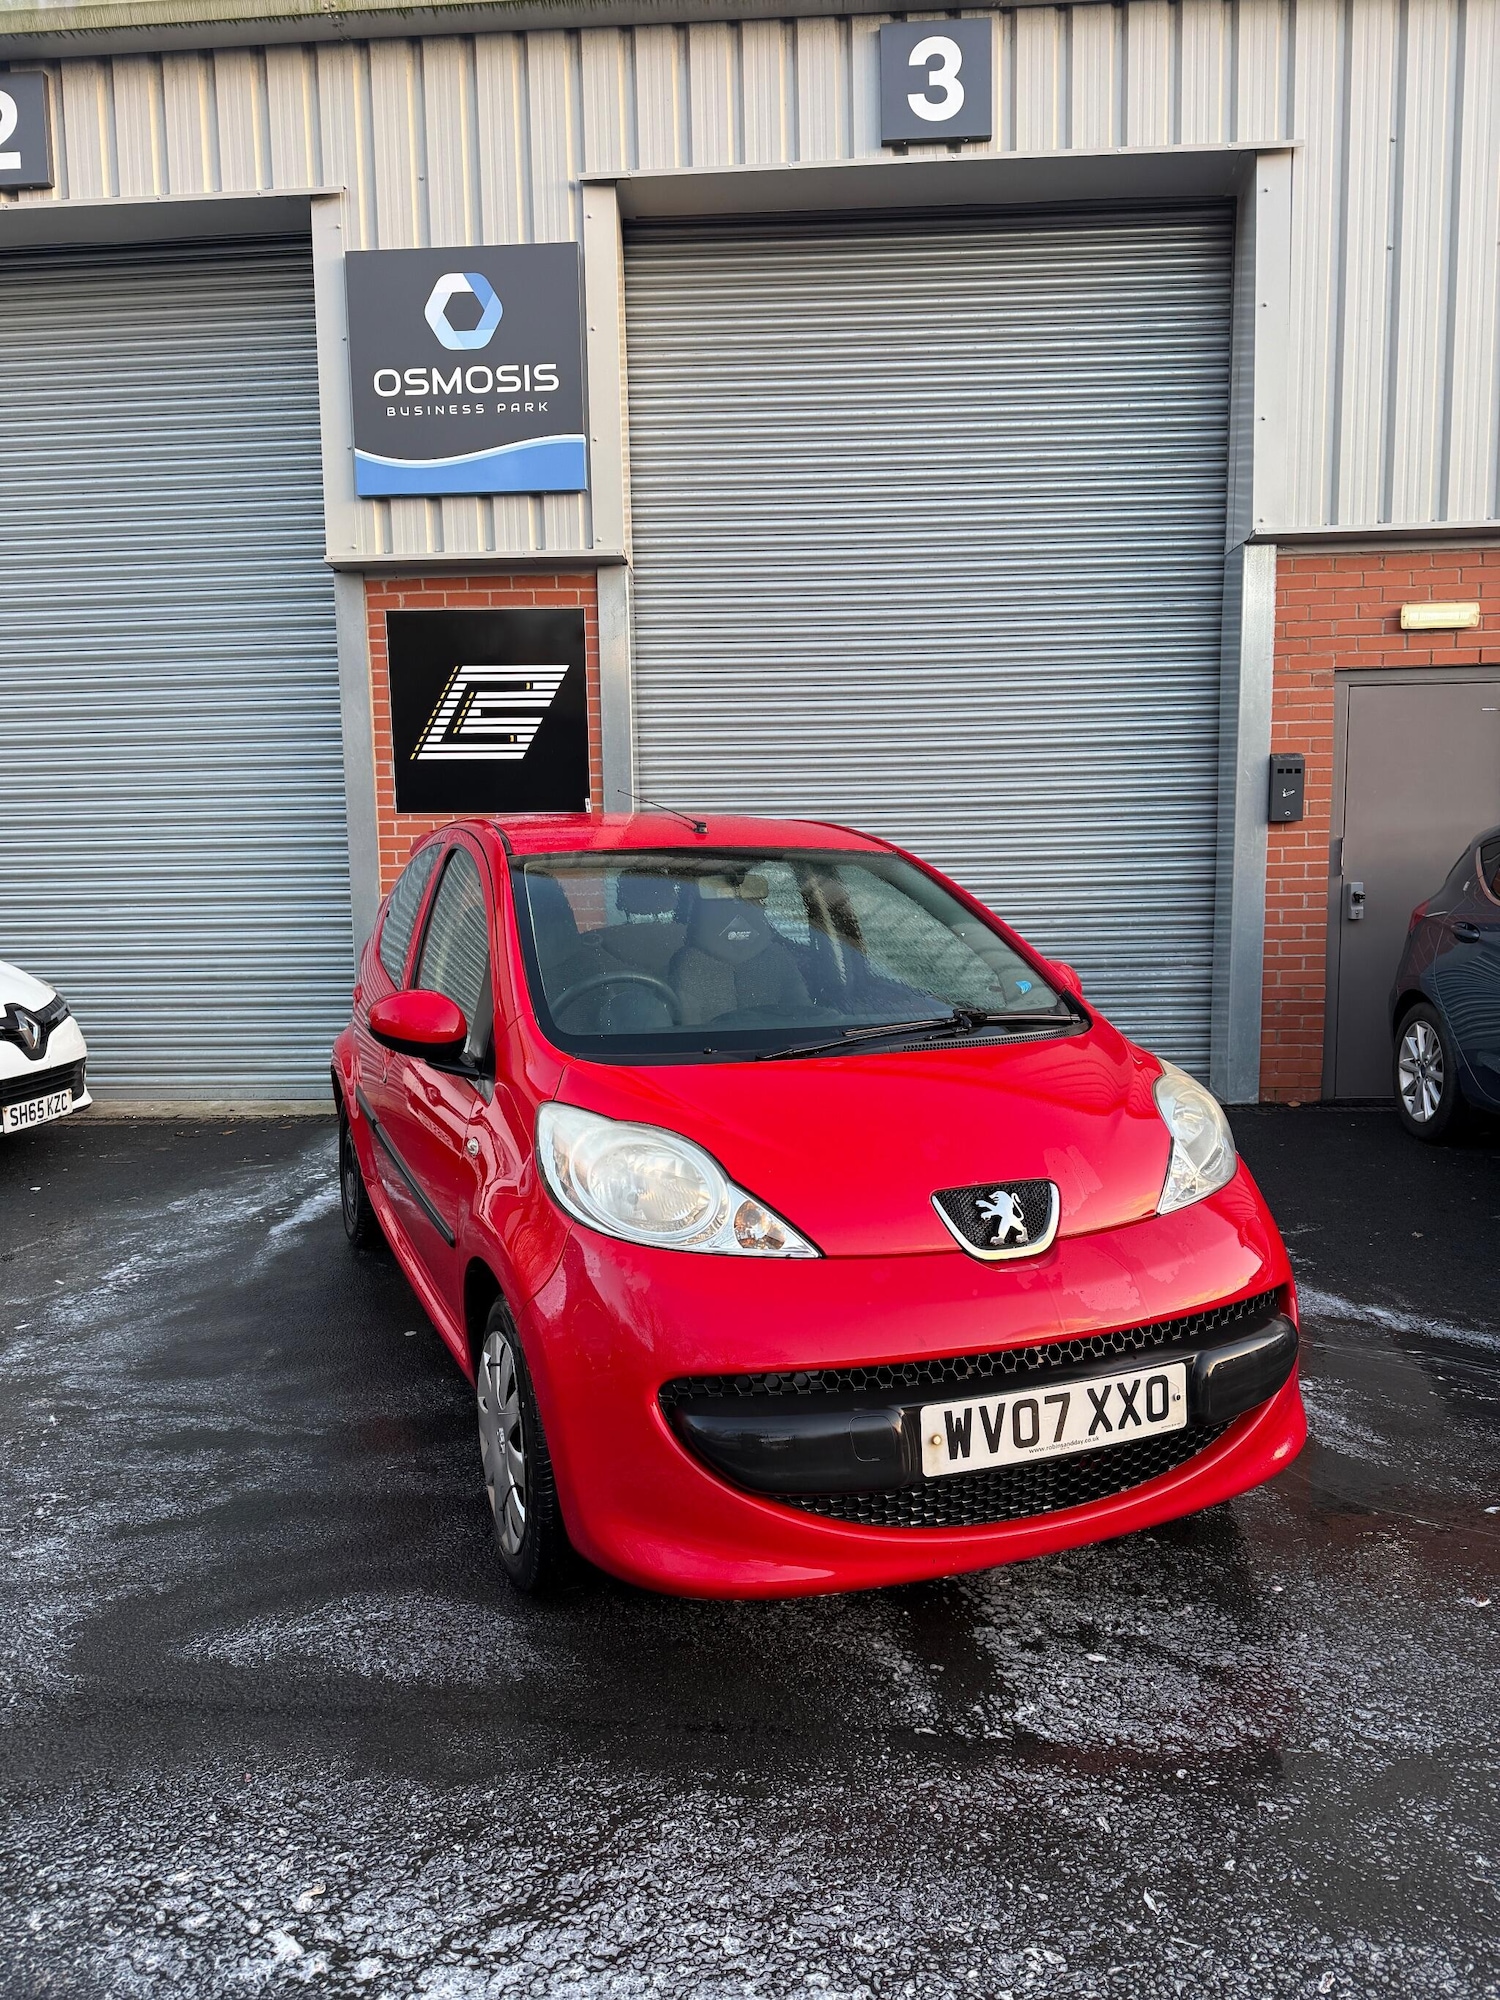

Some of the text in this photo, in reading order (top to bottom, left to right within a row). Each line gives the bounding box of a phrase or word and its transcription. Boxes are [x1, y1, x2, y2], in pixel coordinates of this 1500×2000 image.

[907, 35, 965, 122] 3
[373, 363, 560, 397] OSMOSIS
[386, 401, 549, 417] BUSINESS PARK
[10, 1093, 68, 1126] SH65 KZC
[944, 1374, 1169, 1460] WV07 XXO
